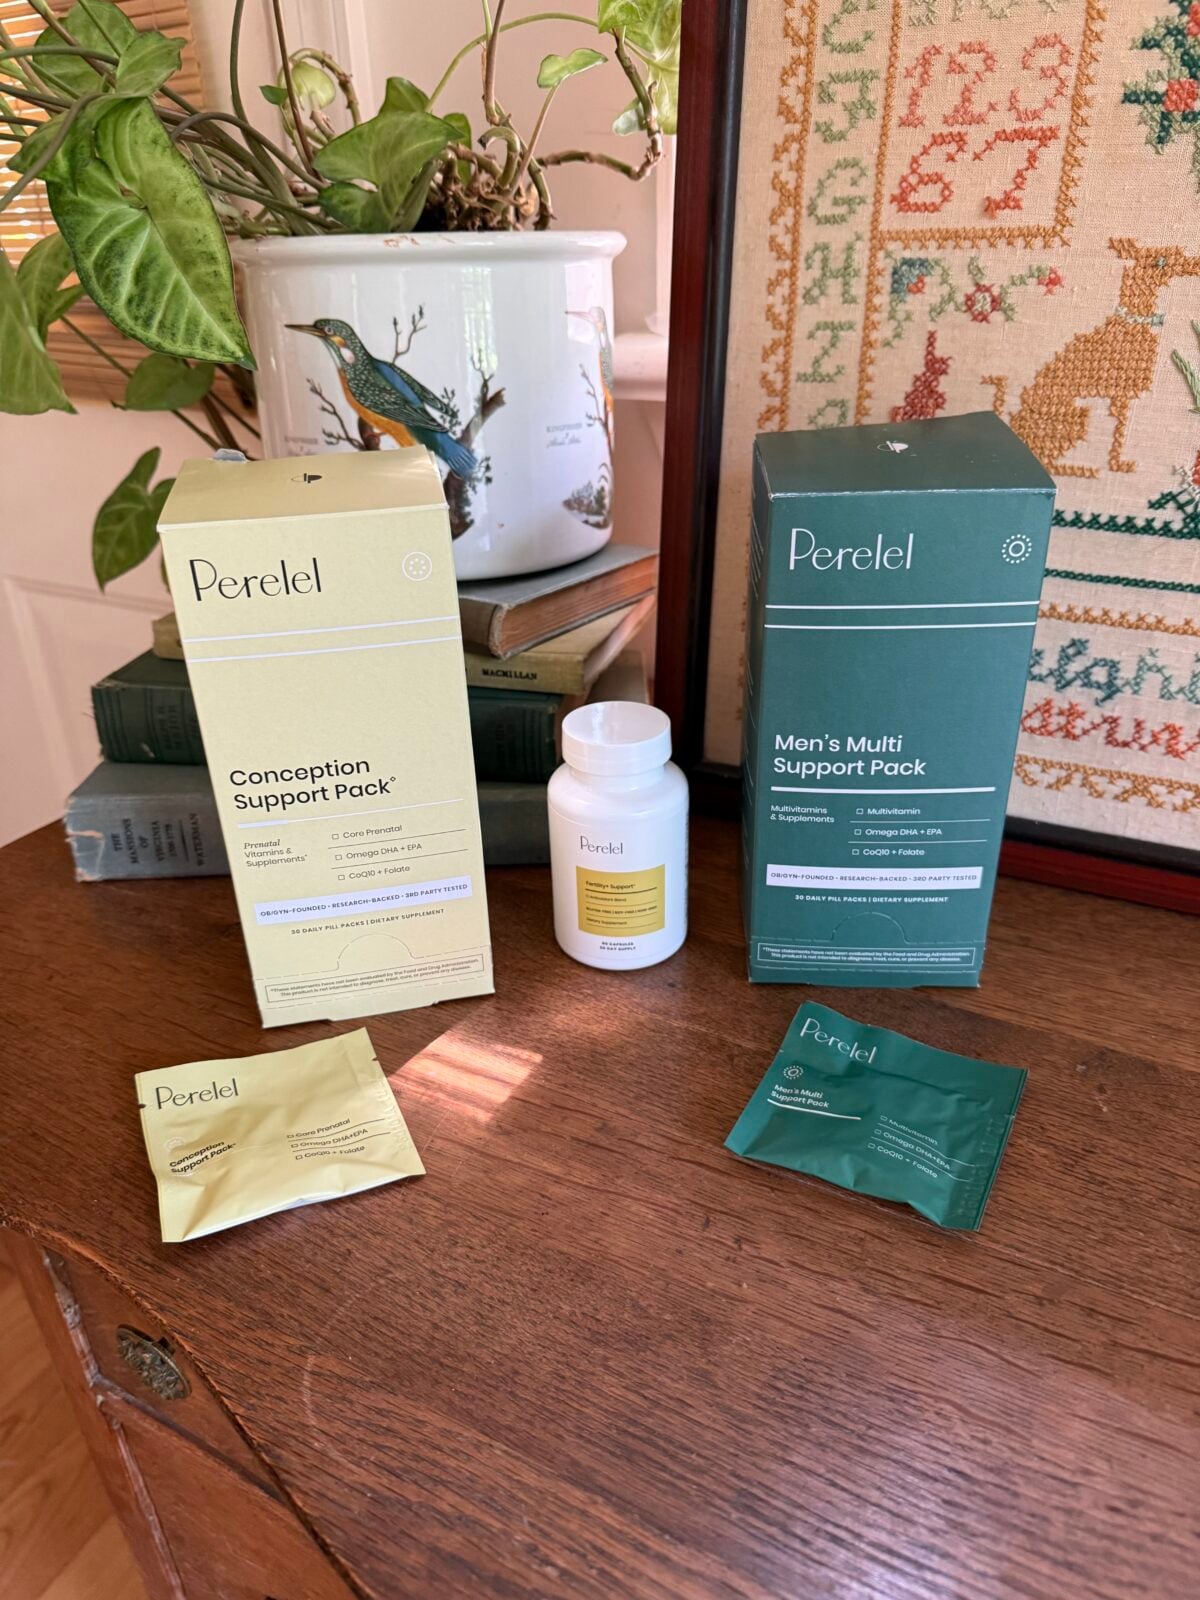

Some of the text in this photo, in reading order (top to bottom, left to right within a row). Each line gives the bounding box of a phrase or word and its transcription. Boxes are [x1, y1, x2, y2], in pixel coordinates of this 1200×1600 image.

[788, 528, 914, 570] Perelel
[188, 556, 322, 602] Perelel
[482, 668, 538, 680] MACMILLAN
[774, 734, 904, 753] Men's Multi
[230, 760, 370, 786] Conception
[773, 757, 927, 780] Support Pack
[234, 786, 330, 812] Support
[770, 805, 828, 814] Multivitamins
[778, 814, 835, 823] Supplements
[366, 824, 402, 836] Prenatal
[865, 829, 898, 837] Omega
[110, 832, 123, 852] THE
[122, 818, 140, 864] MANSIONS
[138, 835, 149, 848] OF
[151, 820, 166, 862] VIRGINIA
[244, 838, 280, 850] Prenatal
[579, 835, 624, 855] Perelel
[245, 849, 284, 858] Vitamins
[346, 850, 379, 859] Omega
[407, 843, 422, 851] EPA
[349, 870, 375, 879] CoQ10
[384, 865, 410, 874] Folate
[260, 904, 326, 916] OB/GYN-FOUNDED
[332, 894, 400, 908] RESEARCH-BACKED
[420, 888, 442, 896] PARTY
[444, 884, 468, 892] TESTED
[370, 916, 399, 924] DIETARY
[401, 908, 444, 920] SUPPLEMENT
[799, 1017, 878, 1064] Perelel
[155, 1077, 239, 1110] Perelel
[770, 1090, 829, 1108] Support Pack
[774, 1084, 824, 1099] Men's Multi
[316, 1118, 351, 1134] Prenatal
[888, 1119, 938, 1146] Multivitamin
[332, 1128, 368, 1144] DHA+EPA
[883, 1132, 914, 1150] Omega
[169, 1141, 225, 1167] Conception
[340, 1146, 365, 1154] Folate
[170, 1154, 212, 1173] Support
[877, 1145, 904, 1160] CoQ10
[912, 1160, 938, 1178] Folate
